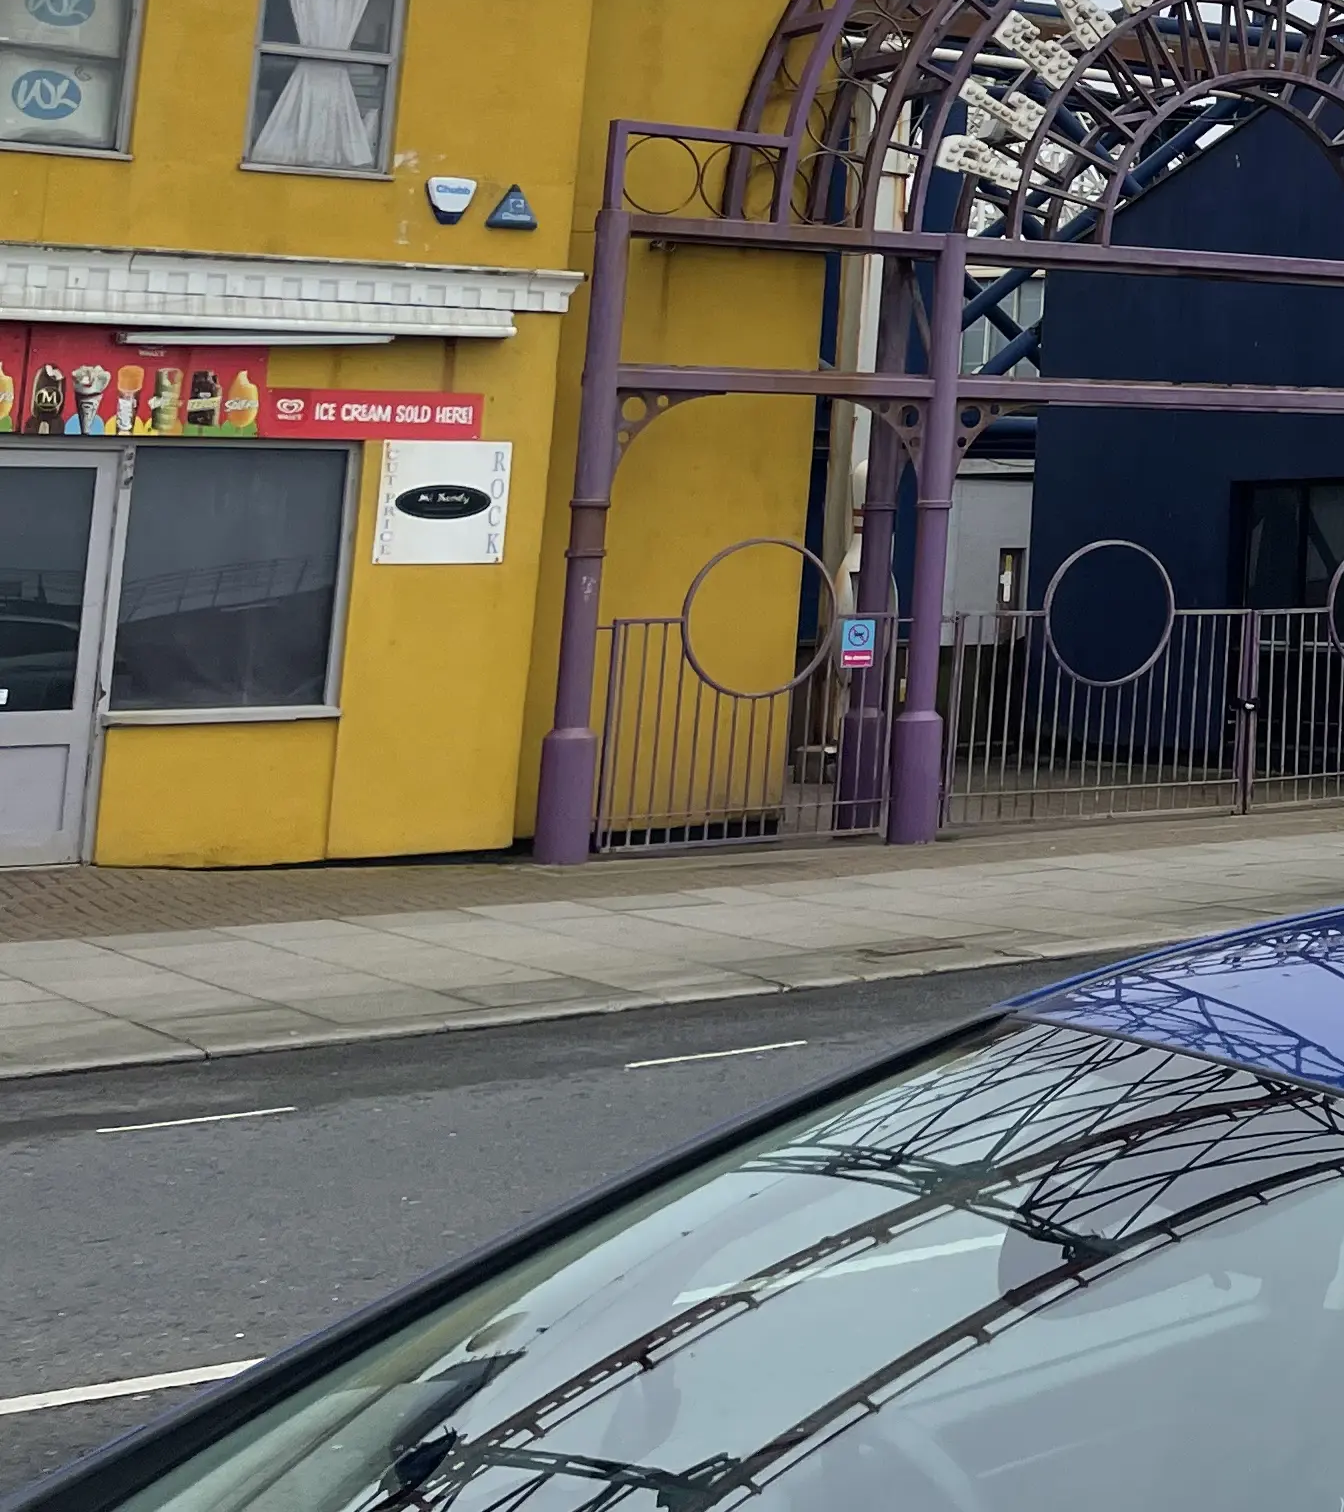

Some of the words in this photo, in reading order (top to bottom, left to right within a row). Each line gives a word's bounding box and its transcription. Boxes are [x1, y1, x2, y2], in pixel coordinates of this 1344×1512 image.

[314, 402, 336, 421] ICE
[341, 403, 391, 423] CREAM
[395, 405, 431, 423] SOLD
[435, 406, 473, 425] HERE!
[486, 451, 506, 555] ROCK
